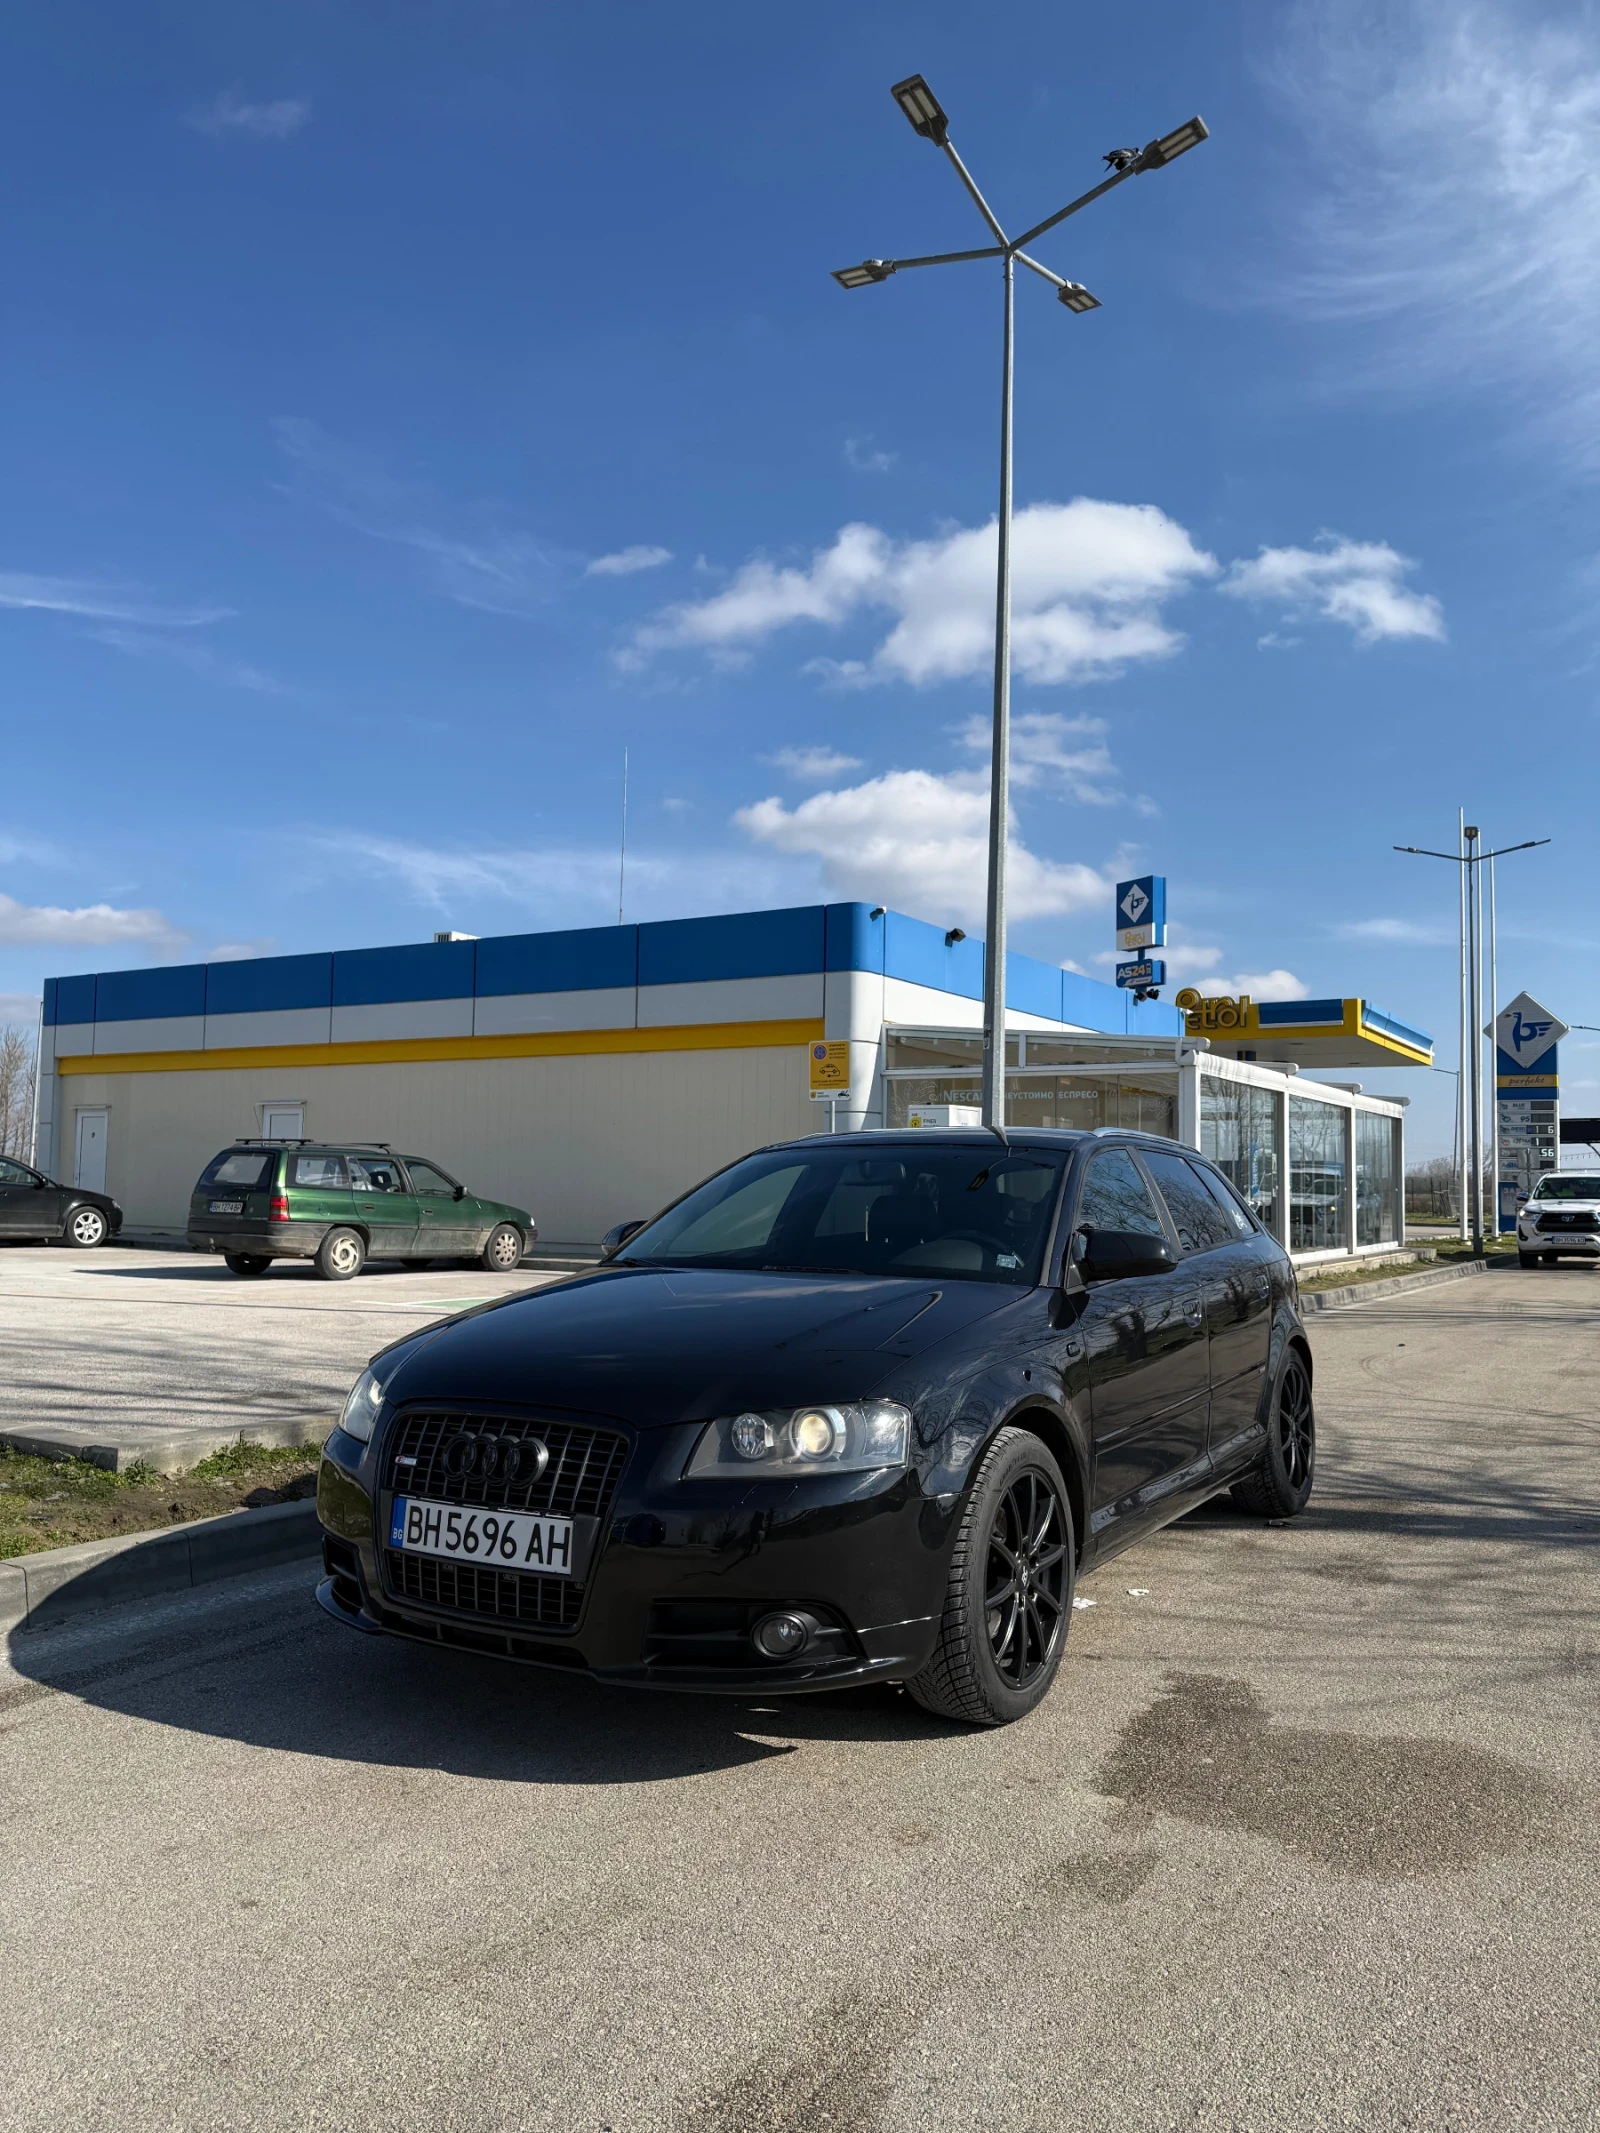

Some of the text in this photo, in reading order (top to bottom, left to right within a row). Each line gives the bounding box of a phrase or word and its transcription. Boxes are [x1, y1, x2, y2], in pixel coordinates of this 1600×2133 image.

[1058, 1090, 1099, 1099] ЕСПРЕСО
[1520, 1115, 1531, 1123] 95
[392, 1527, 404, 1540] BG
[524, 1522, 571, 1567] AH
